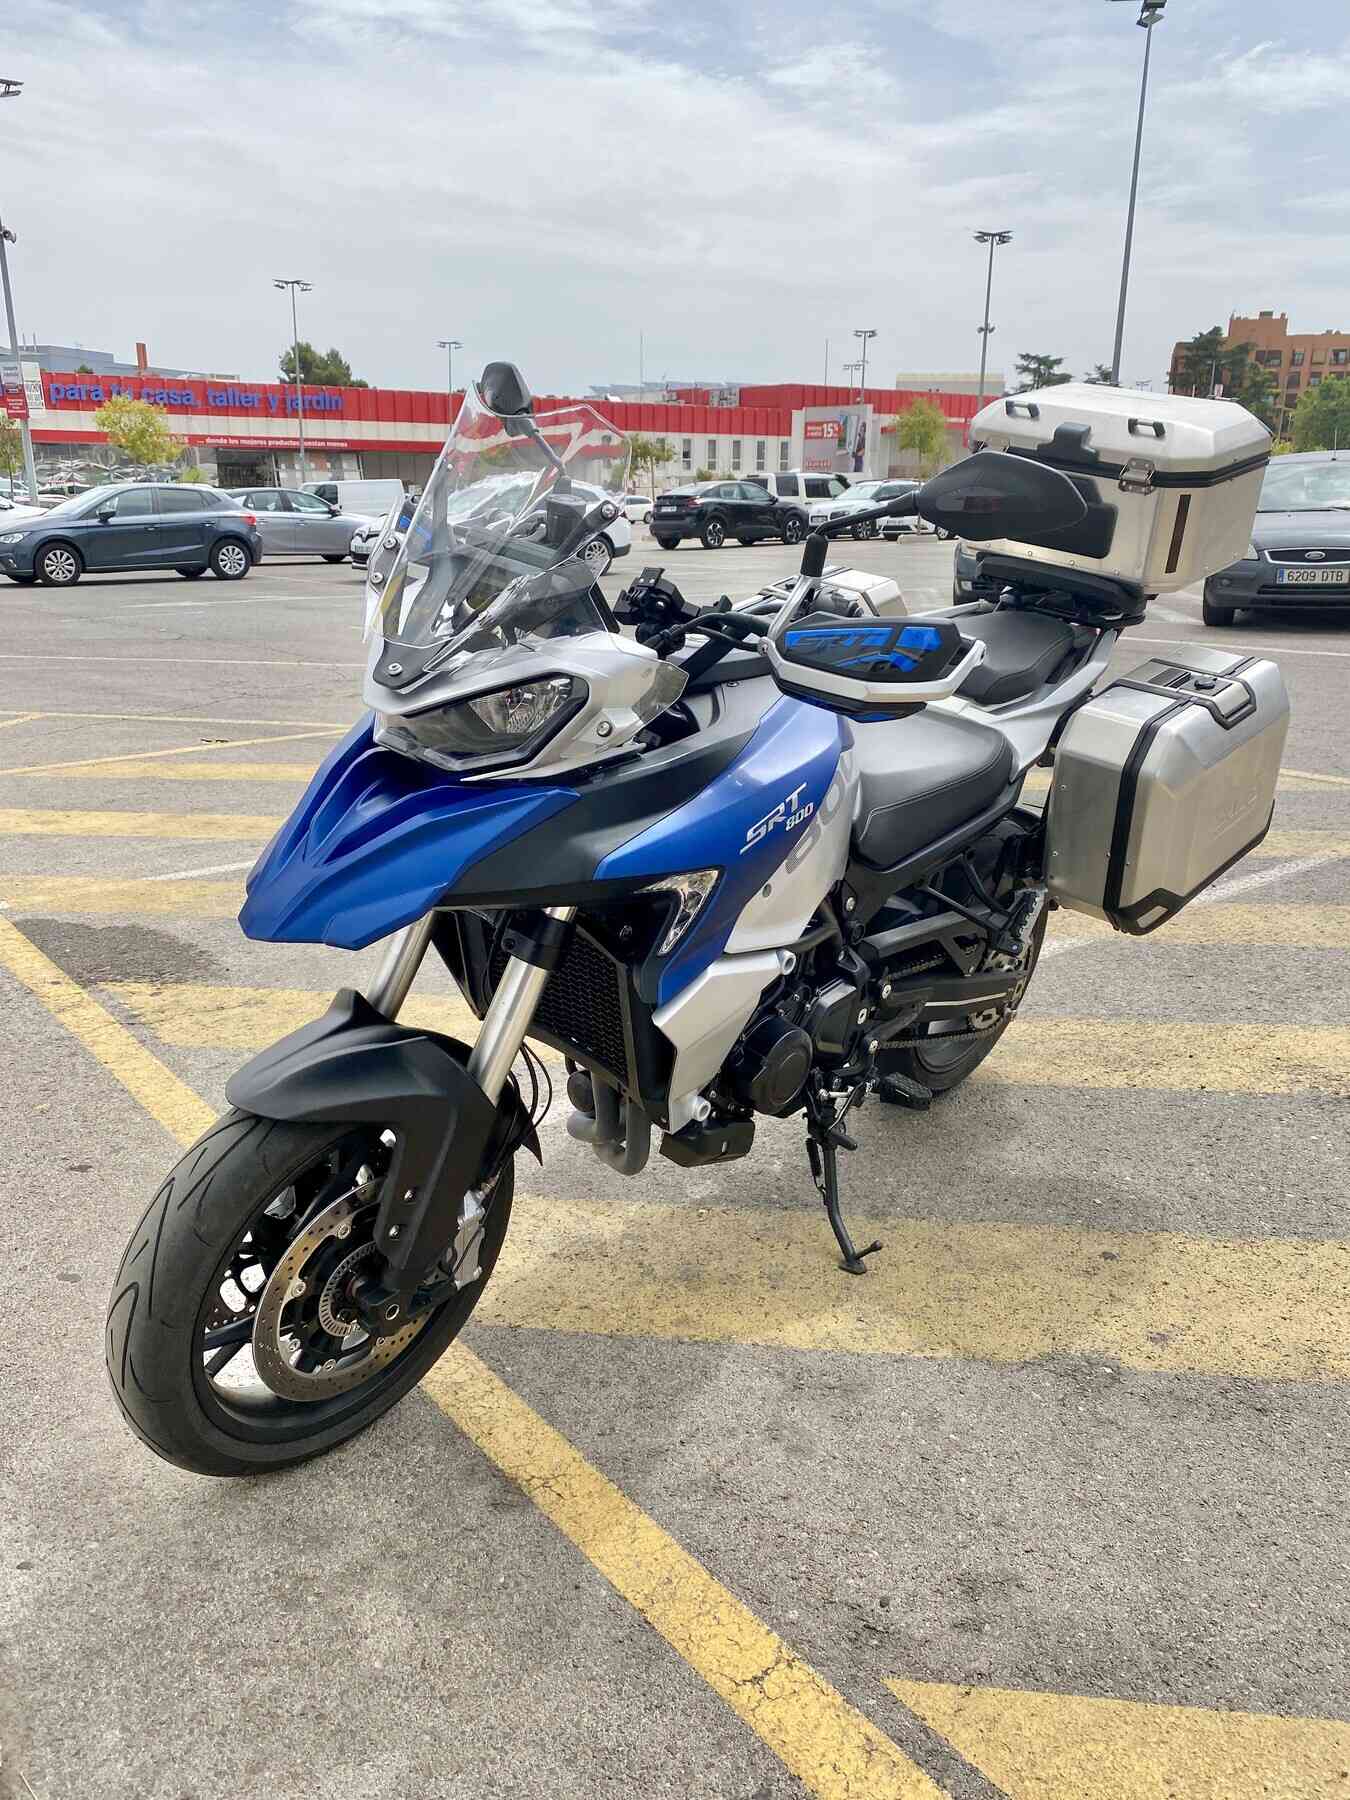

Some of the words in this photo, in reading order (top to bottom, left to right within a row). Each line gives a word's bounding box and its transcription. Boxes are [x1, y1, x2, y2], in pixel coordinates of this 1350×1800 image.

[49, 383, 105, 405] para
[207, 387, 259, 407] taller
[266, 393, 280, 413] y
[1287, 571, 1317, 582] 6209
[1321, 571, 1344, 582] DTB
[739, 782, 807, 855] SRT
[785, 802, 814, 831] 800
